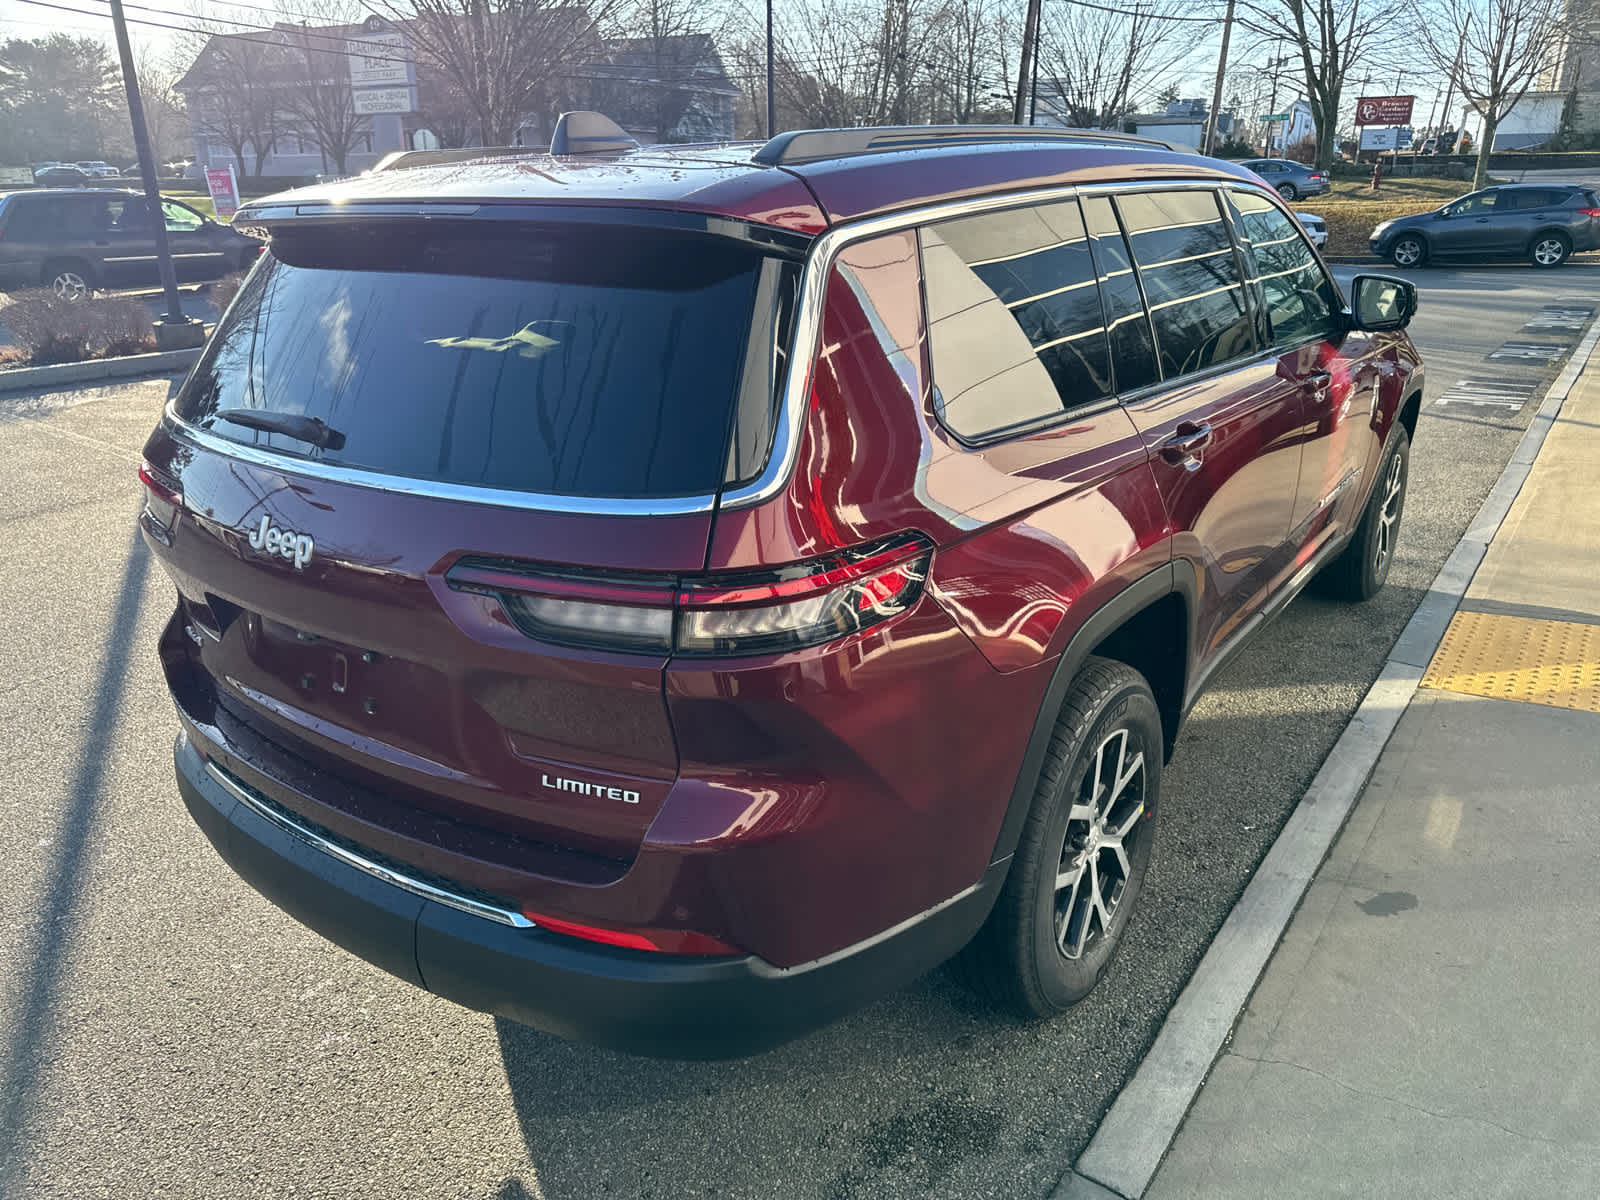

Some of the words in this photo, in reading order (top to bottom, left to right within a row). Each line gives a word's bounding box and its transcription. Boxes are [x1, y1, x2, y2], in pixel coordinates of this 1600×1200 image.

[349, 37, 404, 54] DARTMOUTH
[364, 56, 391, 69] PLACE
[355, 92, 379, 102] MEDICAL
[361, 102, 403, 112] PROFESSIONAL
[249, 514, 314, 569] Jeep
[541, 774, 640, 804] LIMITED
